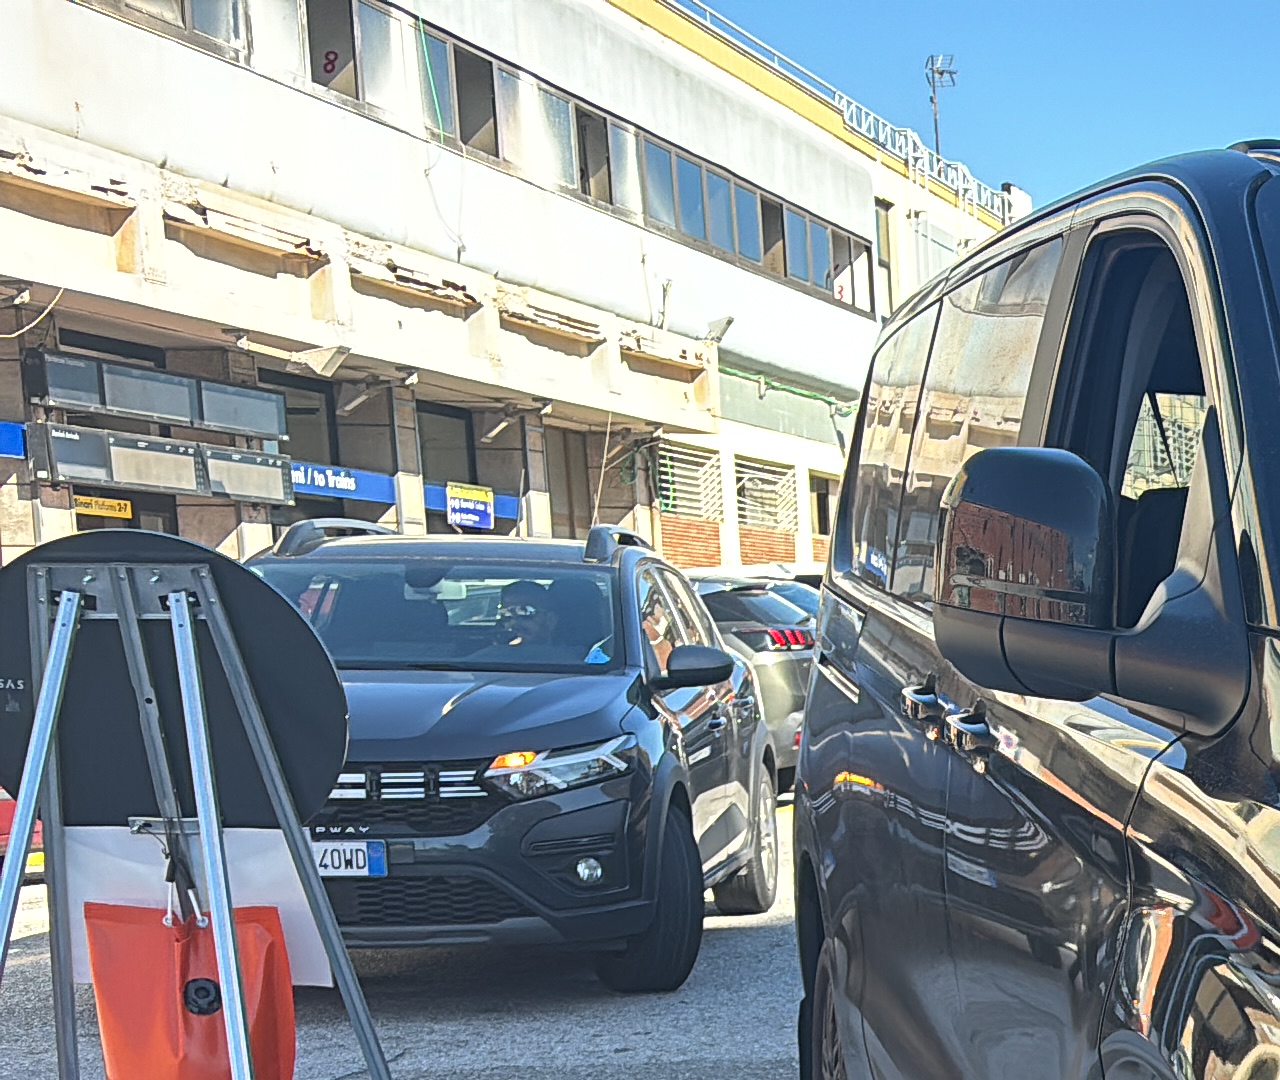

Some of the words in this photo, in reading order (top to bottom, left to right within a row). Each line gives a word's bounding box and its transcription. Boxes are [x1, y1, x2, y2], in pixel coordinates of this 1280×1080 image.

[323, 50, 338, 74] 8
[314, 470, 325, 486] to
[326, 469, 356, 490] Trains
[315, 826, 370, 834] PWAY
[319, 848, 367, 870] 40WD
